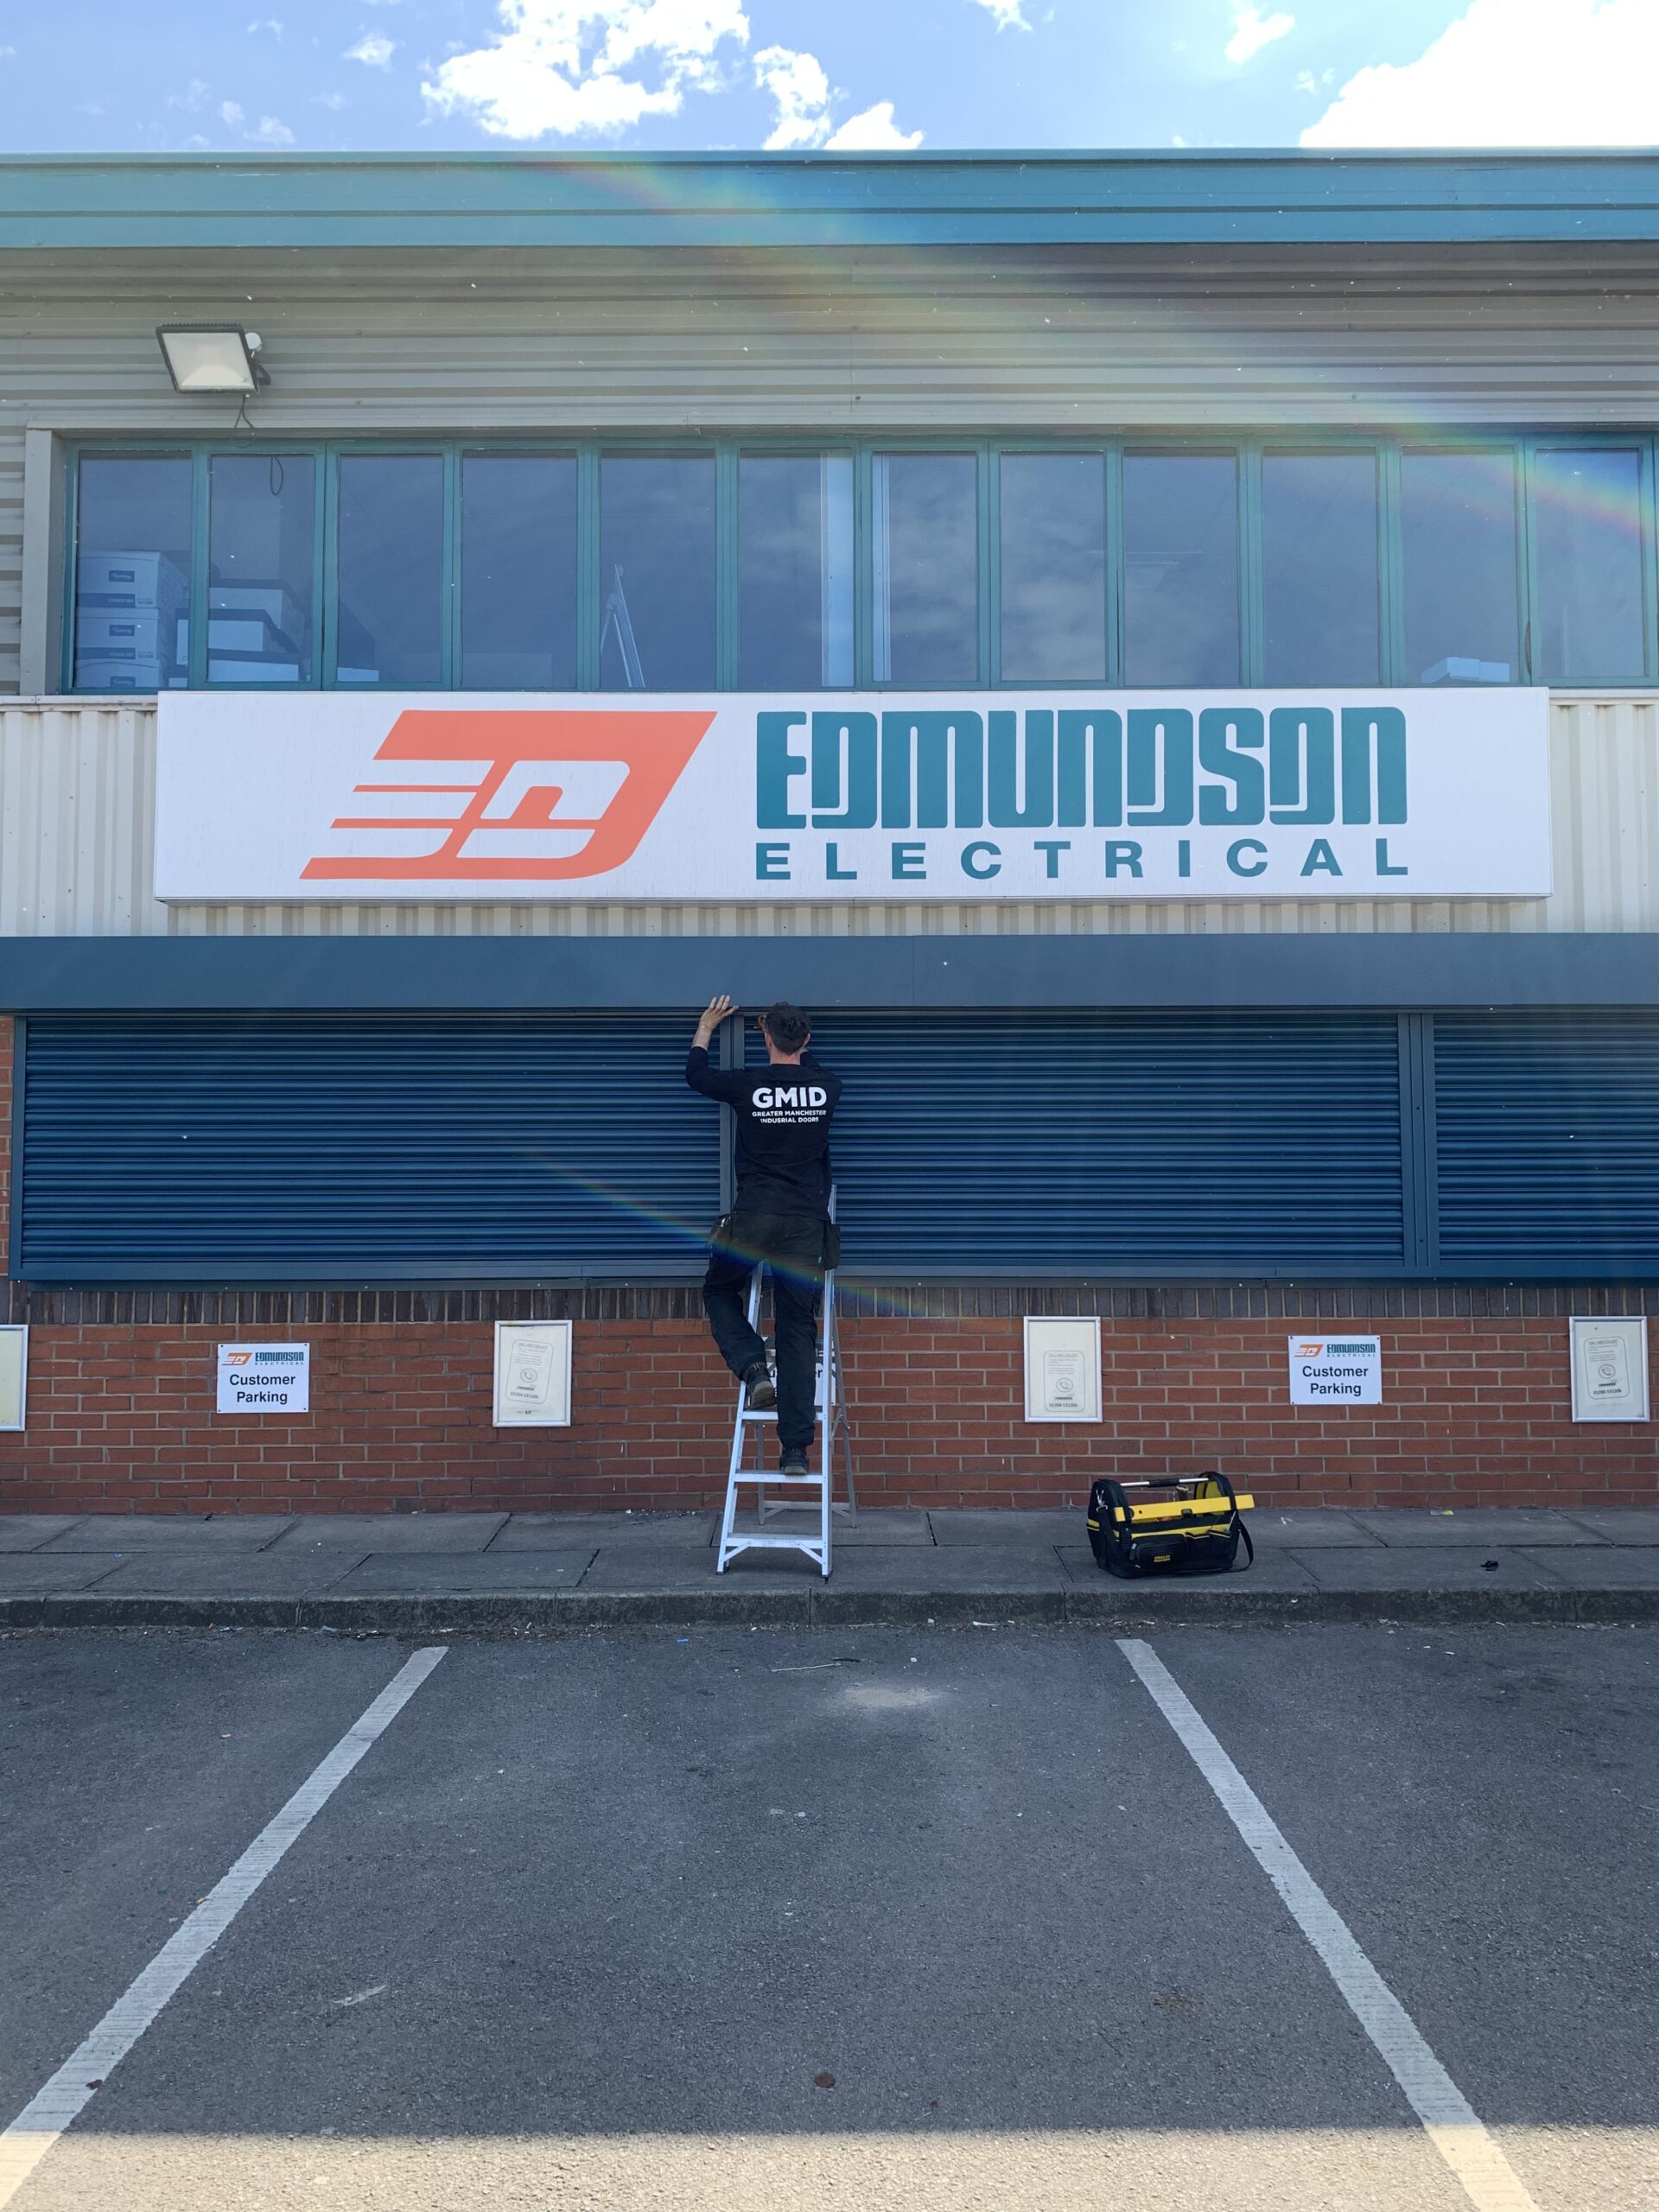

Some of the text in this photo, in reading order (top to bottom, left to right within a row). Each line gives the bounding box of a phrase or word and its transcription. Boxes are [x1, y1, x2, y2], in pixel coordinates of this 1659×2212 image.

[757, 706, 1407, 830] EDMUNDSON
[756, 837, 1408, 880] ELECTRICAL
[752, 1087, 827, 1109] GMID
[1326, 1344, 1376, 1353] EDMUNDSON
[255, 1352, 304, 1362] EDMUNDSON
[1302, 1365, 1369, 1377] Customer
[229, 1374, 296, 1386] Customer
[1310, 1382, 1362, 1397] Parking
[237, 1391, 288, 1405] Parking
